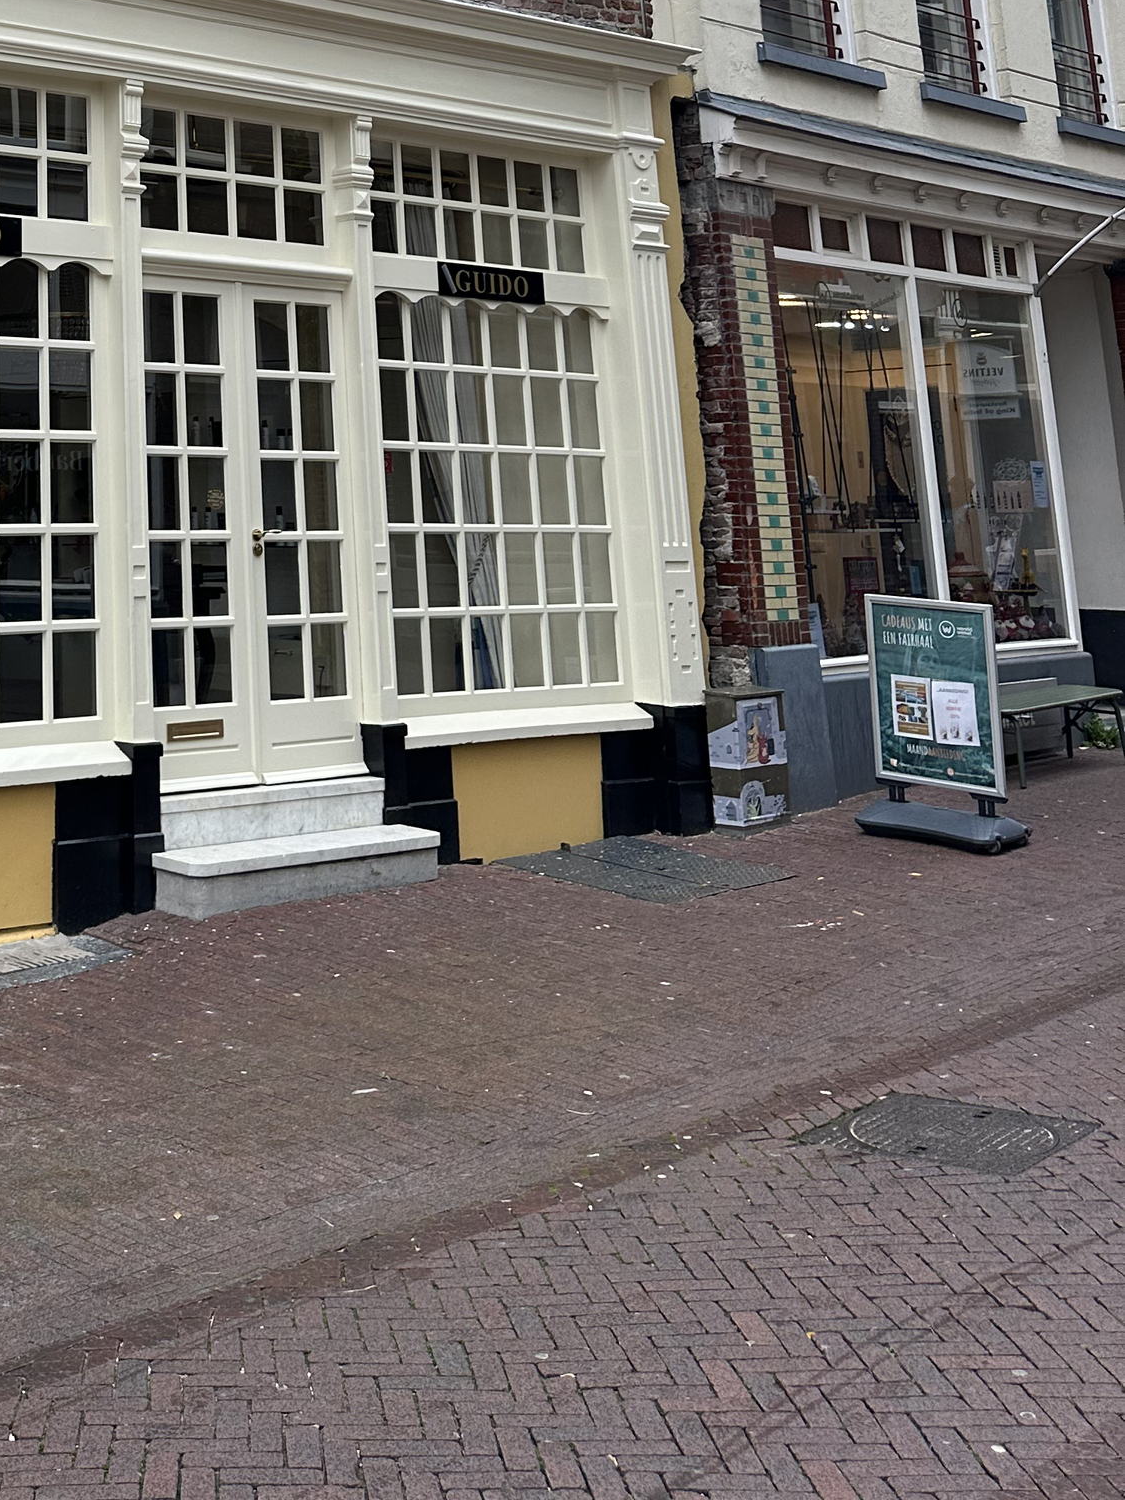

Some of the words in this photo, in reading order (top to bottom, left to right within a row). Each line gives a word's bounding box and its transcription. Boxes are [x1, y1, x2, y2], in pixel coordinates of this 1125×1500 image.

[455, 269, 529, 298] GUIDO
[881, 614, 915, 630] CADEAUS
[917, 618, 933, 632] MET
[882, 631, 896, 645] EEN
